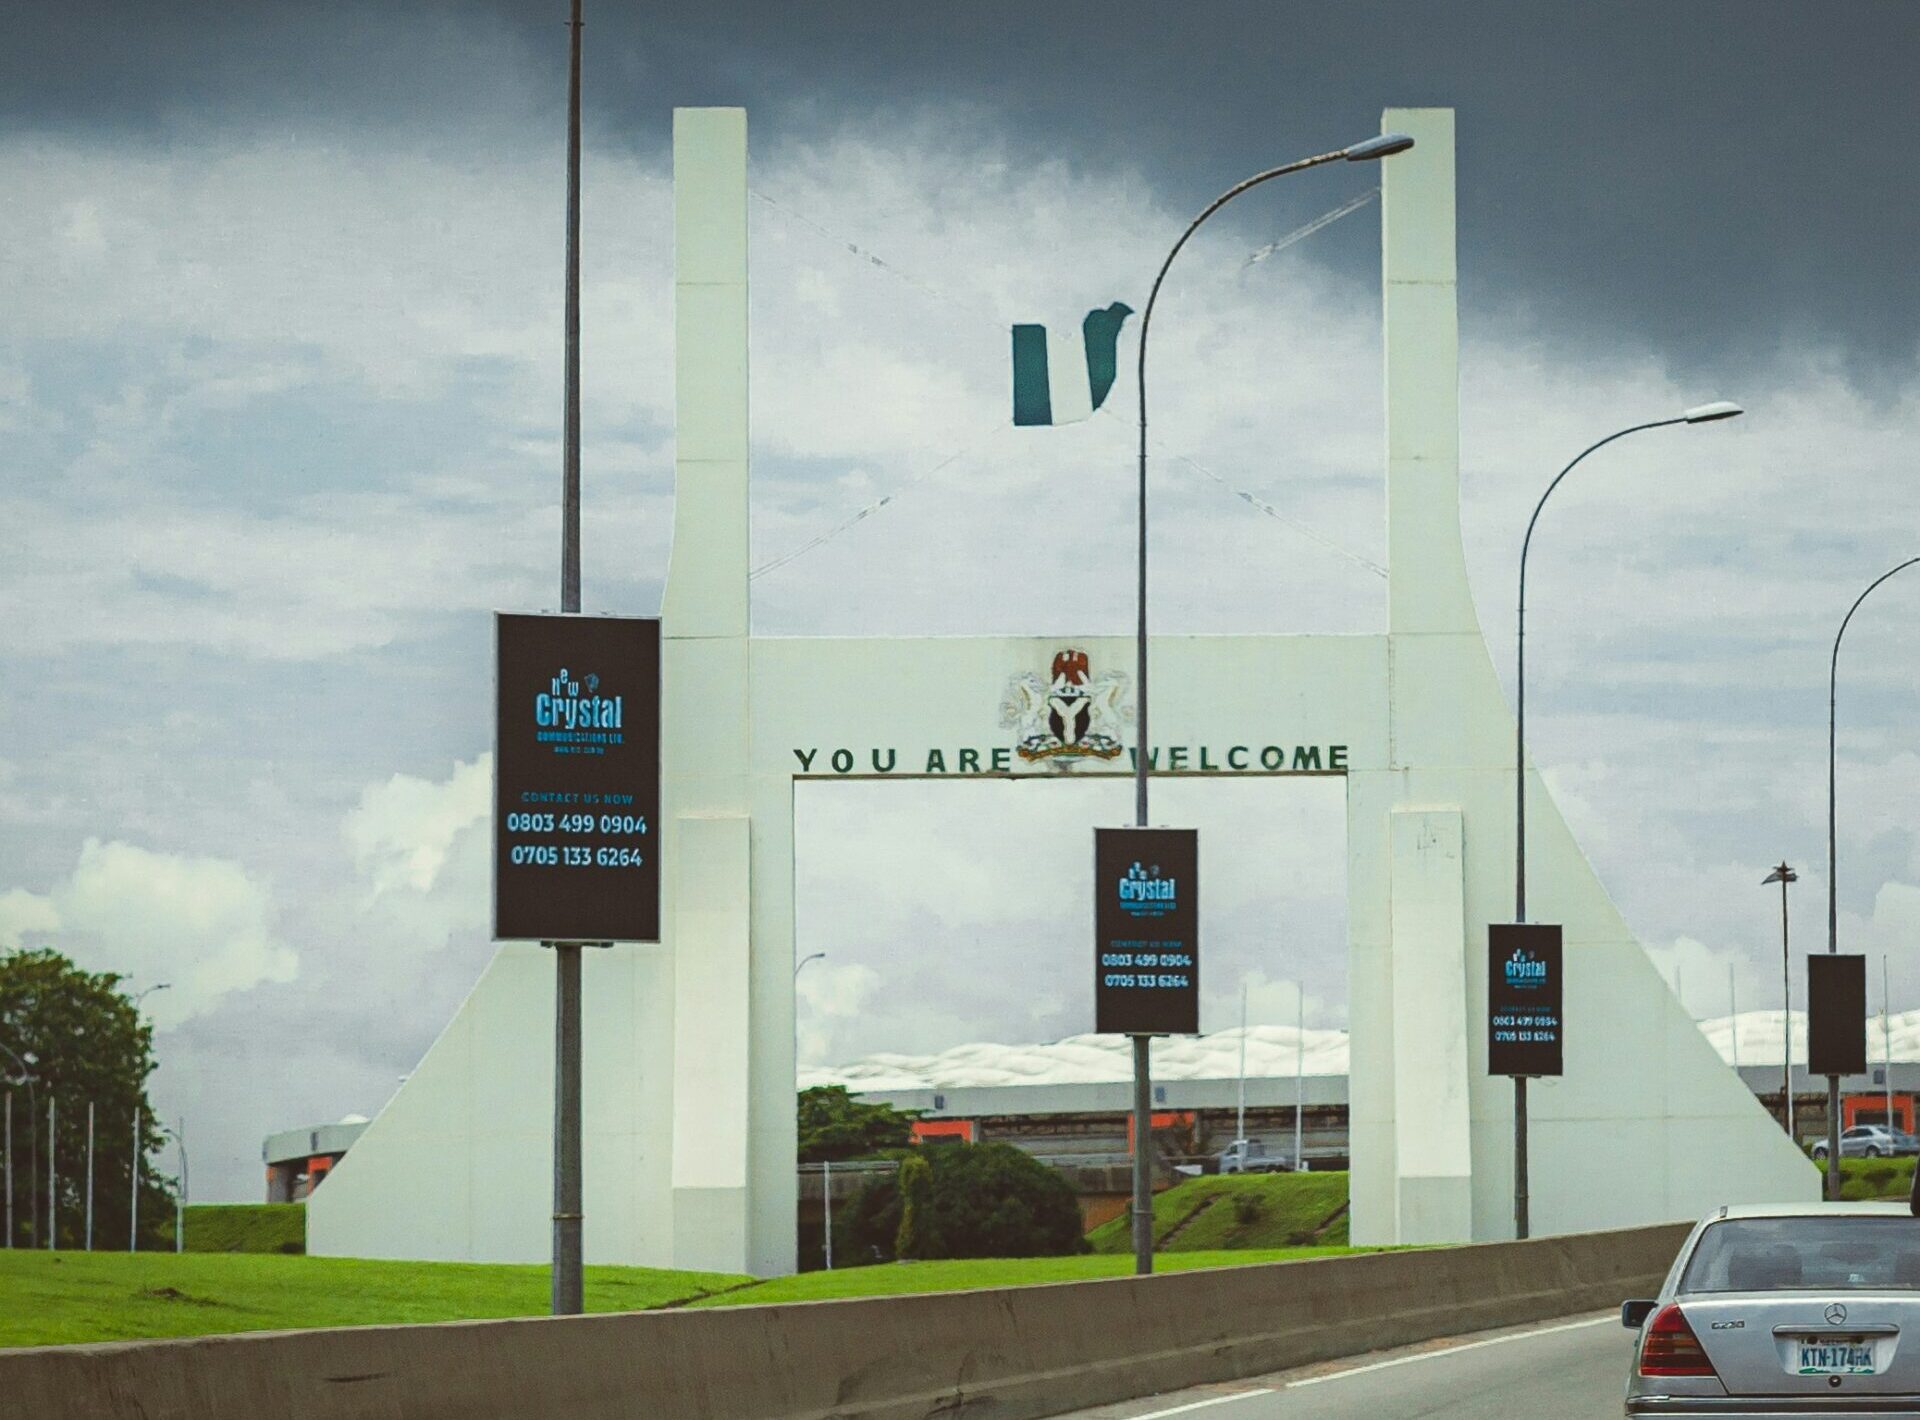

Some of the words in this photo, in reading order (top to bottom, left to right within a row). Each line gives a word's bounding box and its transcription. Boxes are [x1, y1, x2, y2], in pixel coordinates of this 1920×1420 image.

[536, 693, 622, 730] Crystal
[793, 748, 896, 773] YOU
[926, 748, 1011, 773] ARE
[1128, 745, 1348, 770] WELCOME
[521, 792, 578, 804] CONTACT
[584, 793, 600, 804] US
[604, 794, 633, 805] NOW
[507, 812, 555, 832] 0803
[558, 814, 595, 833] 499
[601, 815, 648, 835] 0904
[511, 845, 558, 865] 0705
[563, 846, 592, 866] 133
[597, 847, 642, 867] 6264
[1119, 878, 1176, 900] Crystal
[1505, 960, 1546, 978] Crystal
